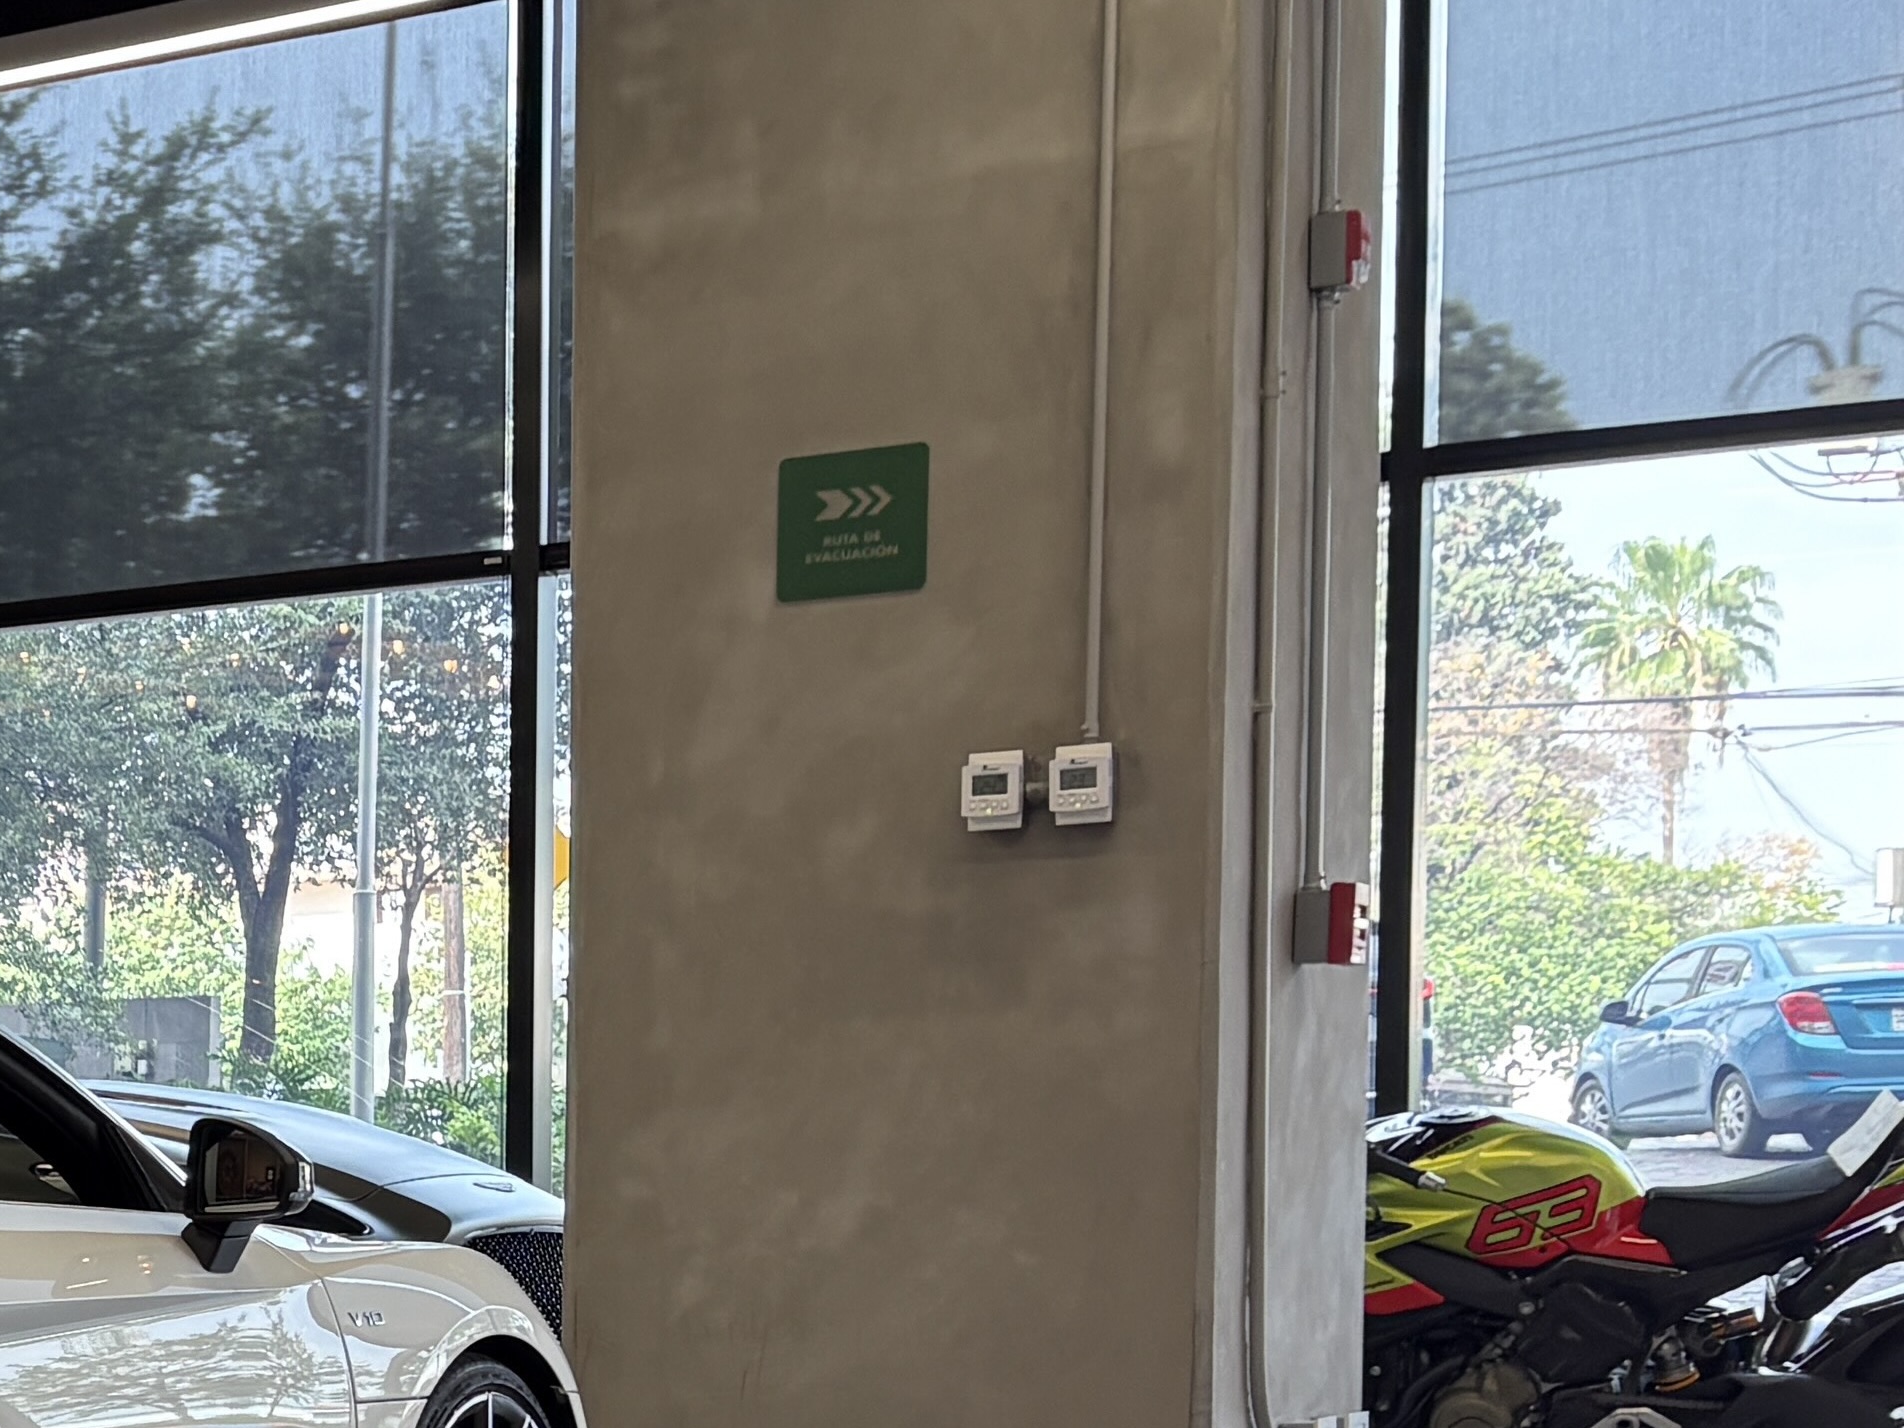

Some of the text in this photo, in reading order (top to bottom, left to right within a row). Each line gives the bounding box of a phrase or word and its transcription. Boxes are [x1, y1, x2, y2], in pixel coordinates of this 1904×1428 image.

[822, 532, 860, 547] RUTA
[1464, 1173, 1603, 1256] 63
[347, 1310, 386, 1327] V10
